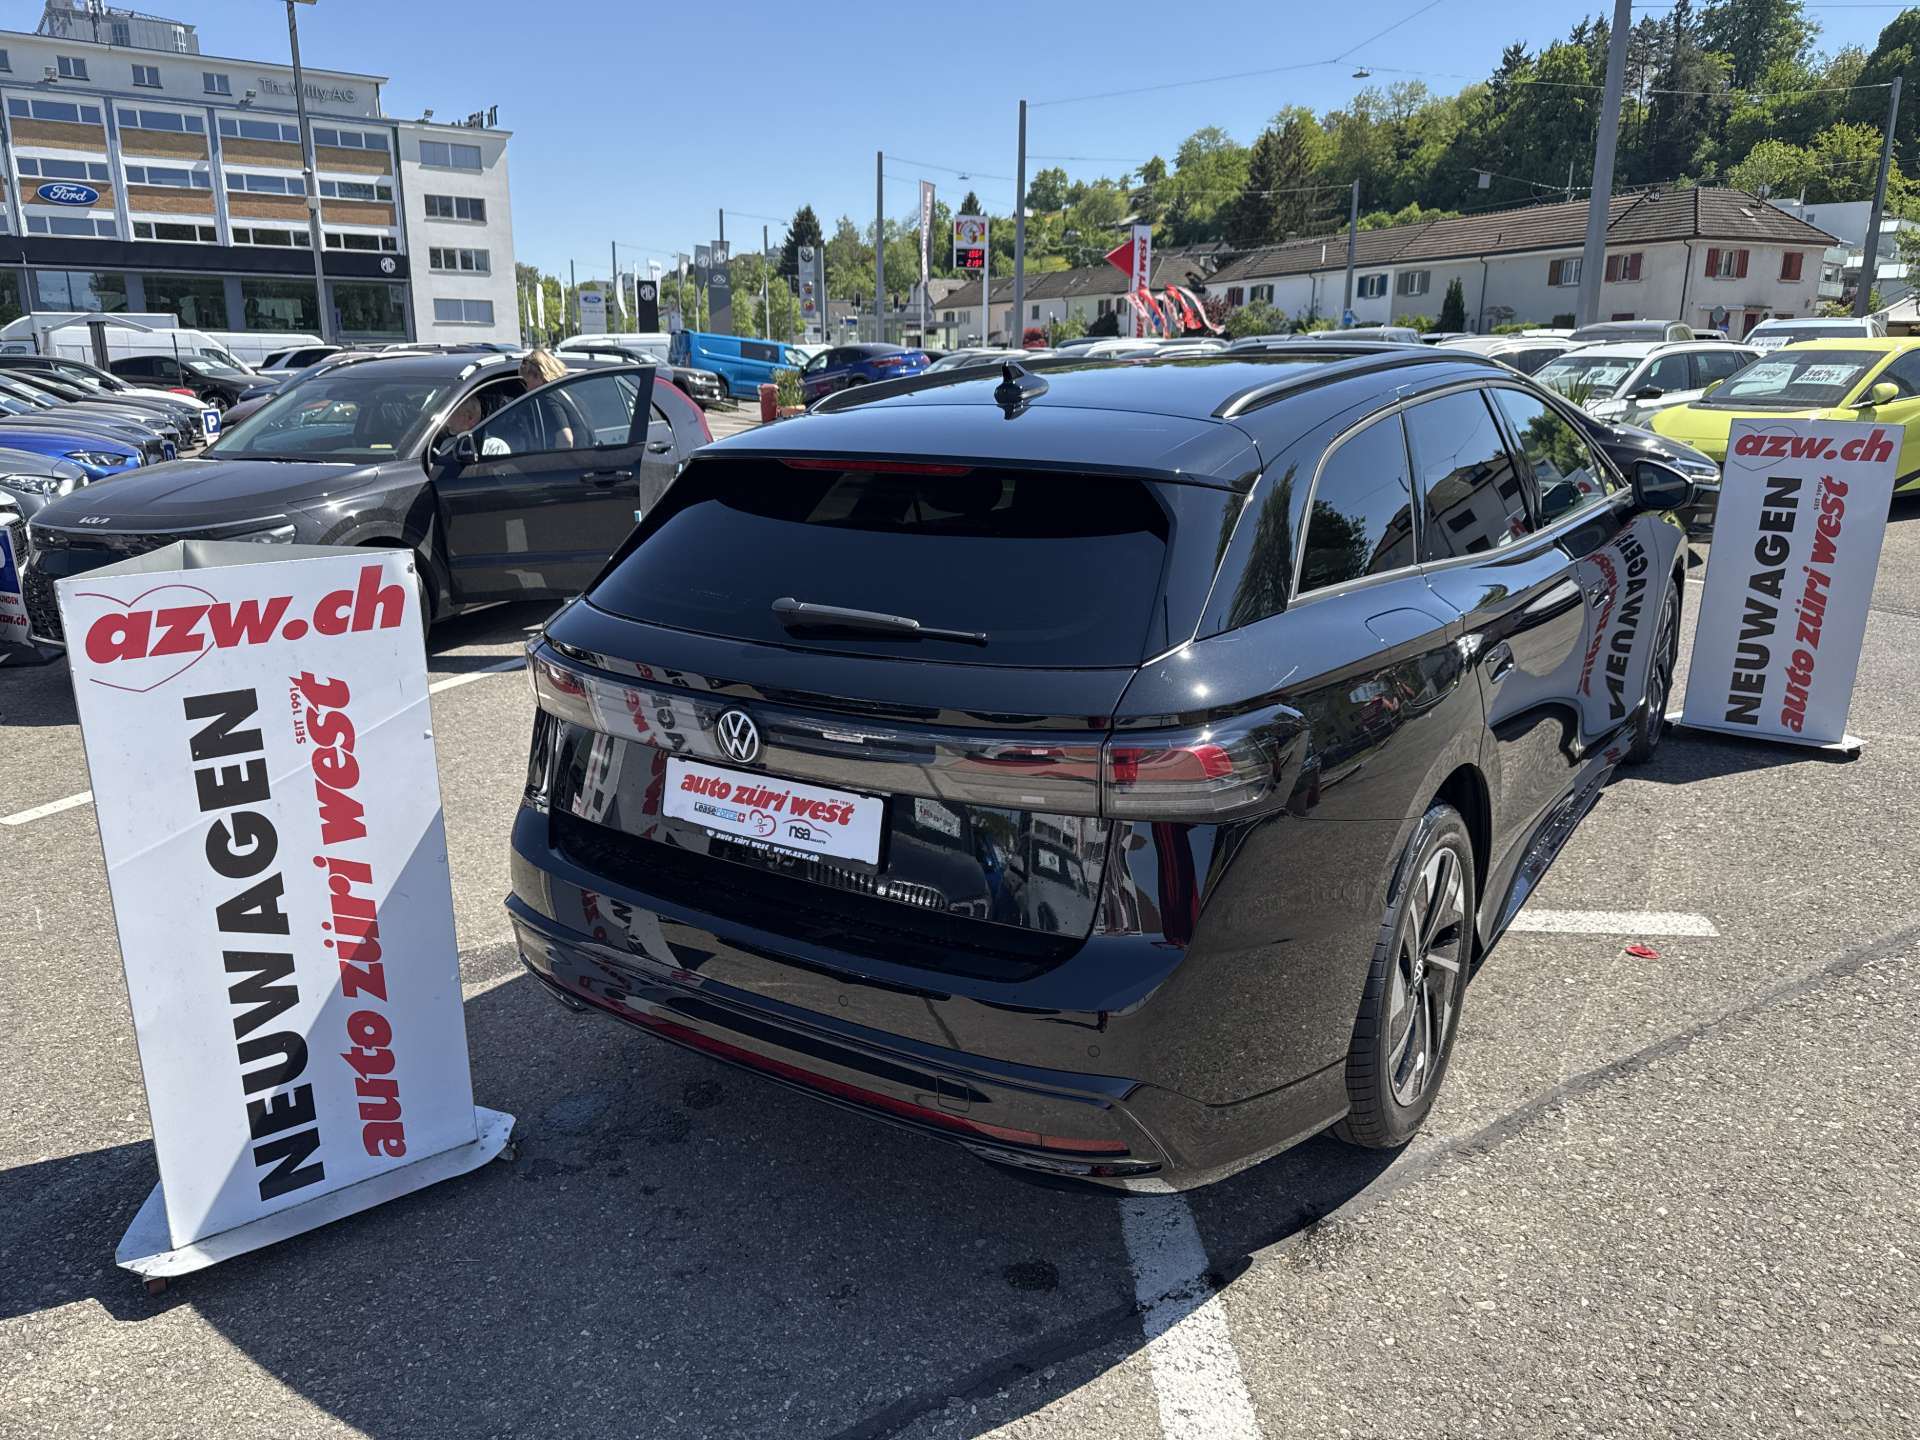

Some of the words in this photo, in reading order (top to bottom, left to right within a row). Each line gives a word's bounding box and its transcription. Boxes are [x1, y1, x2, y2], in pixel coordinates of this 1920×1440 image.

[331, 87, 359, 103] AG
[50, 185, 87, 201] Ford
[207, 414, 217, 431] P
[1735, 429, 1894, 463] azw.ch
[1811, 475, 1849, 565] west
[85, 564, 405, 665] azw.ch
[1725, 476, 1803, 726] NEUWAGEN
[1796, 565, 1832, 650] züri
[290, 687, 302, 715] 1991
[1781, 648, 1815, 734] auto
[288, 671, 368, 846] west
[294, 719, 306, 744] SEIT
[680, 774, 732, 800] auto
[731, 784, 790, 813] züri
[790, 796, 855, 826] west
[789, 825, 811, 841] nsa
[716, 832, 732, 842] auto
[751, 840, 770, 851] west
[183, 687, 325, 1202] NEUWAGEN
[314, 855, 388, 1003] züri
[340, 1010, 407, 1158] auto
